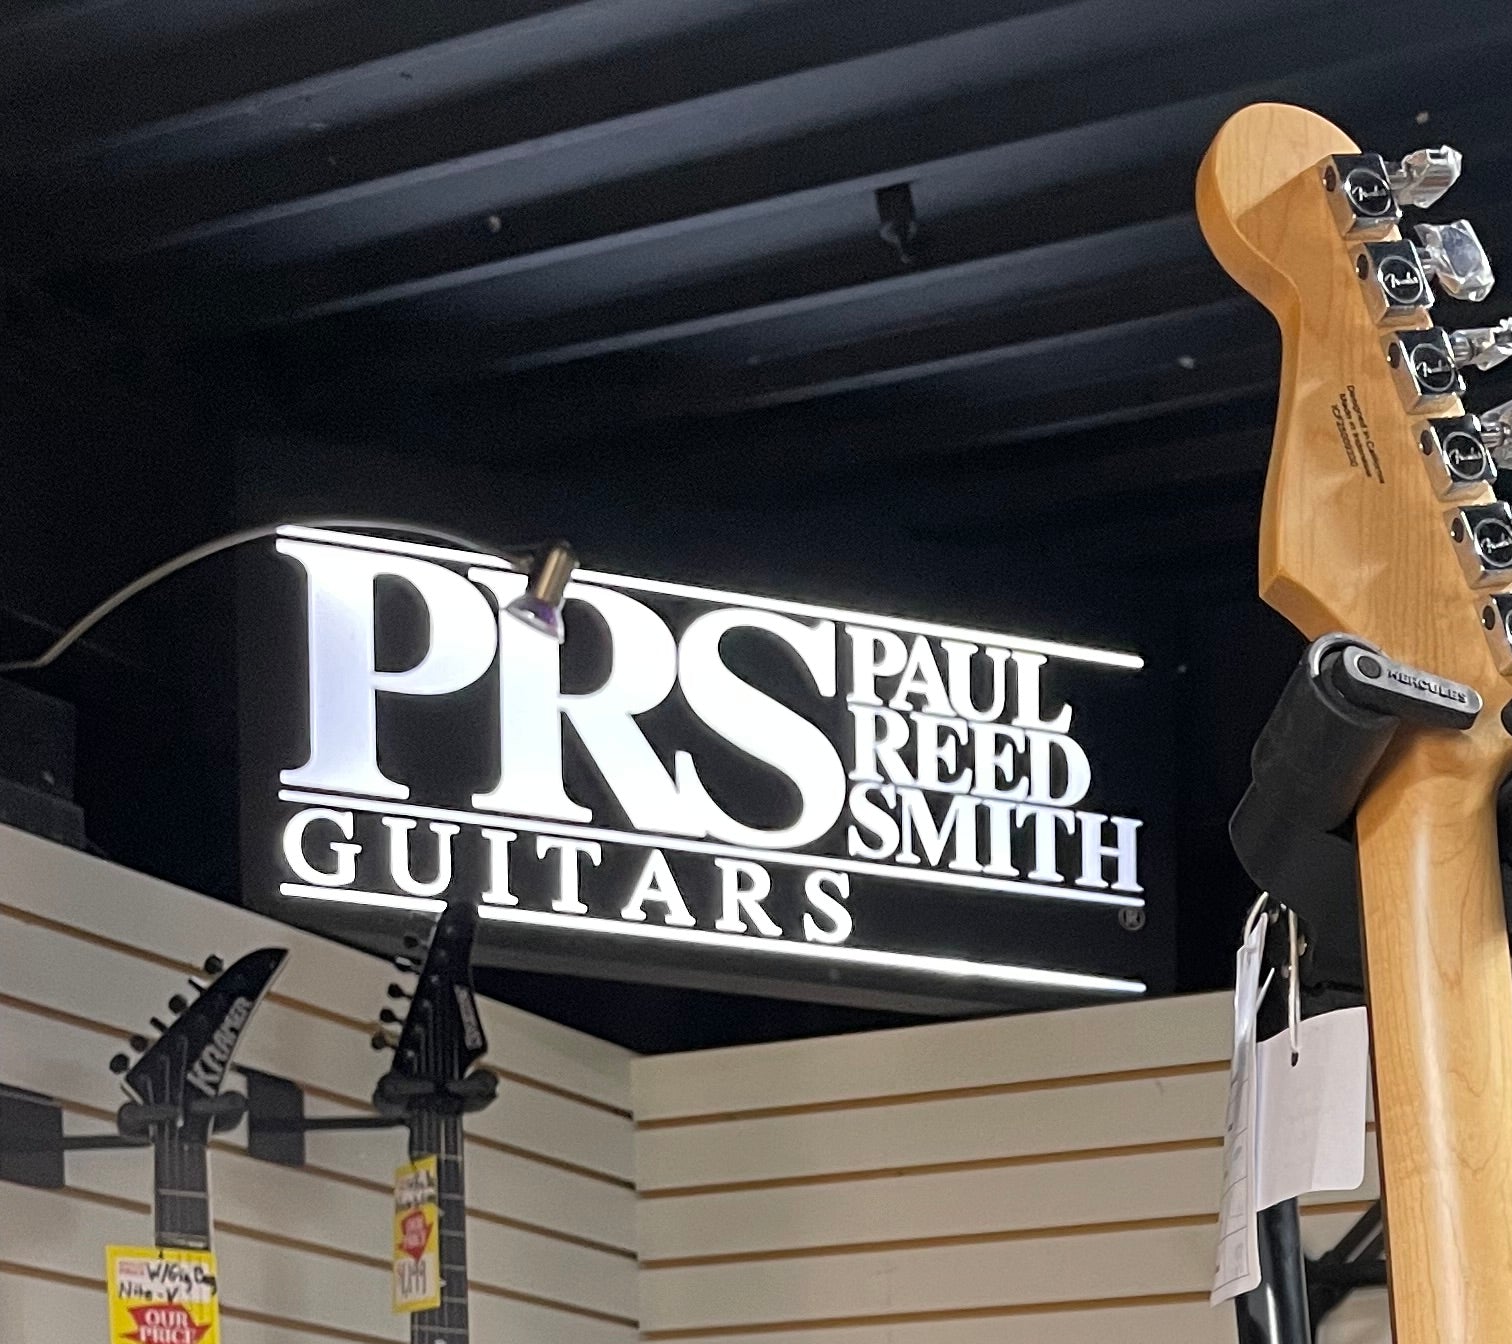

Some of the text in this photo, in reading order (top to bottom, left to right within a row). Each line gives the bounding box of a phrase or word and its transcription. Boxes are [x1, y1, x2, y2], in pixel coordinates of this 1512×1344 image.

[276, 538, 848, 850] PRS
[845, 622, 1073, 734] PAUL
[1386, 668, 1467, 704] HERCULES
[848, 701, 1092, 808] REED
[282, 807, 853, 945] GUITARS
[849, 782, 1145, 893] SMITH
[144, 1308, 189, 1328] OUR
